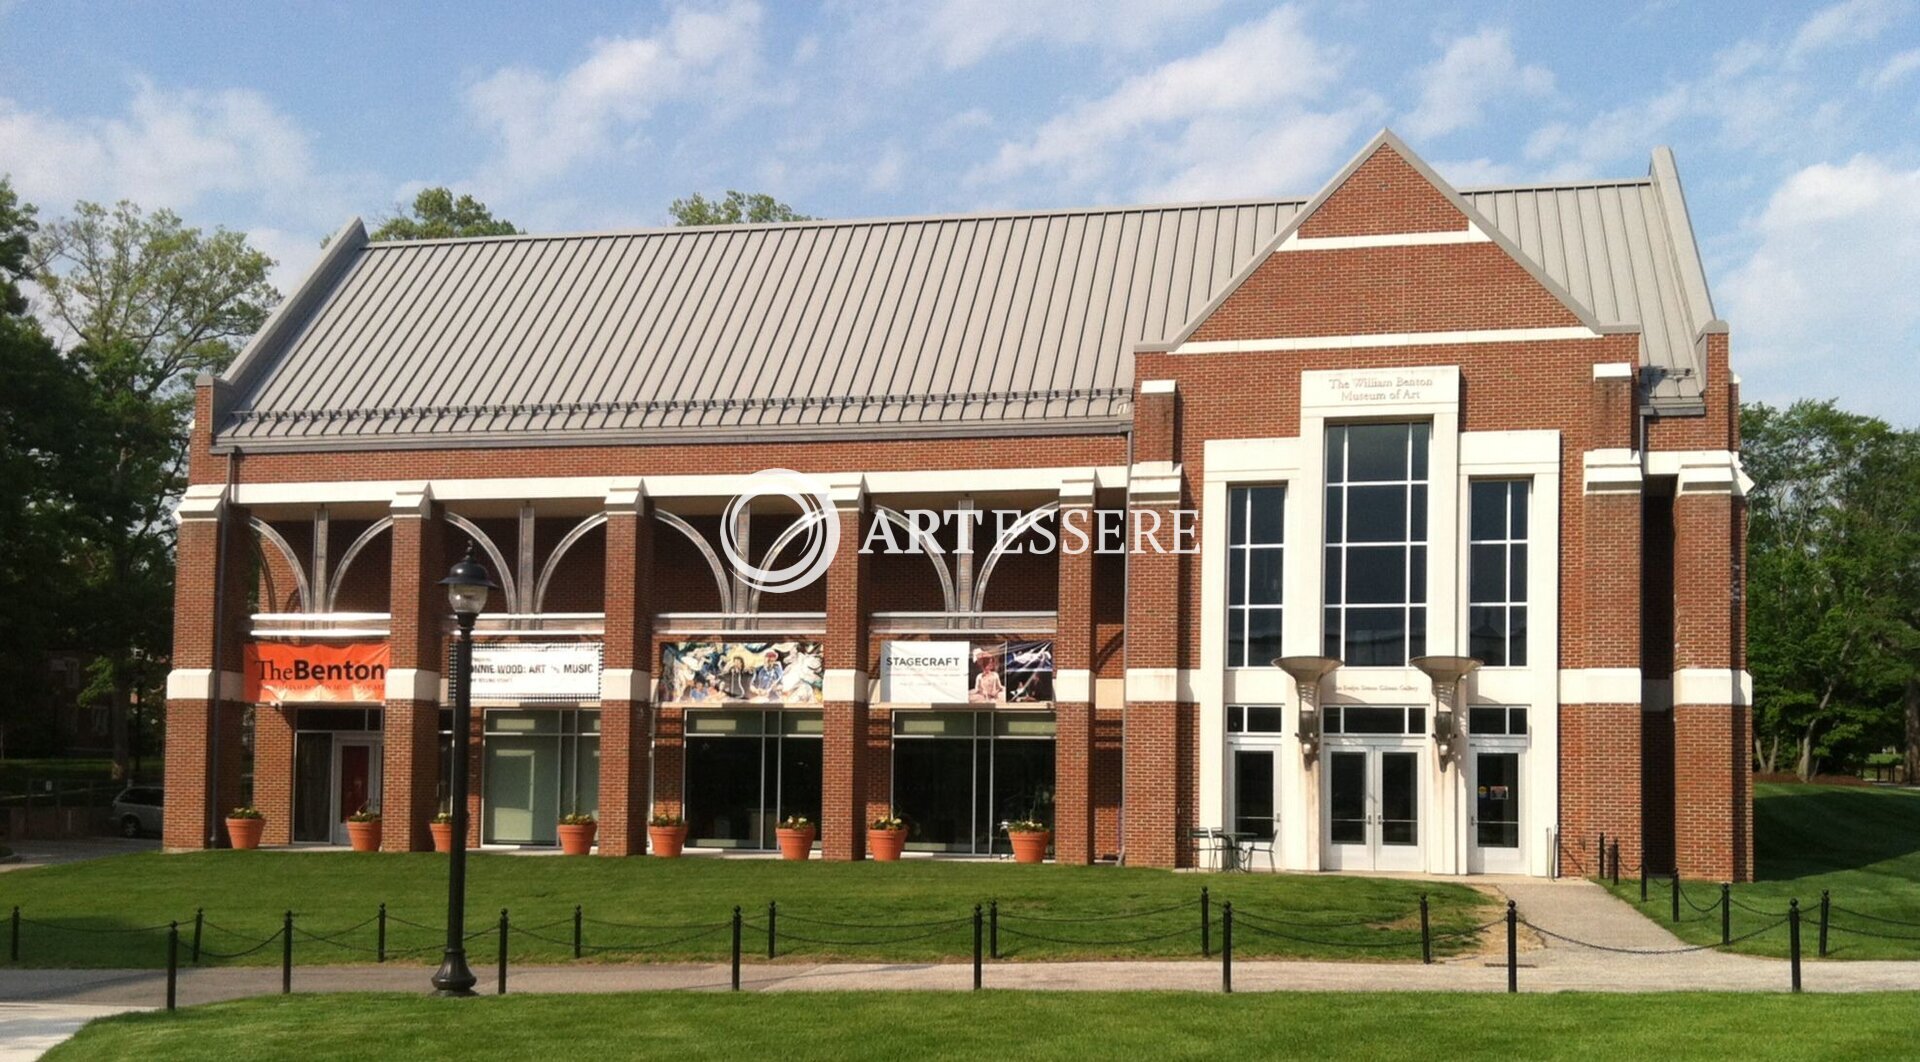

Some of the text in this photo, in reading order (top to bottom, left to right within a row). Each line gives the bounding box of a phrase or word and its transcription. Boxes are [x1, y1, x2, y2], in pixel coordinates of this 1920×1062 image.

[1328, 376, 1433, 390] The William Benton
[1341, 389, 1420, 401] Museum of Art
[886, 657, 960, 667] STAGECRAFT
[470, 664, 495, 674] ONNIE
[528, 664, 547, 674] ART
[563, 664, 594, 674] MUSIC
